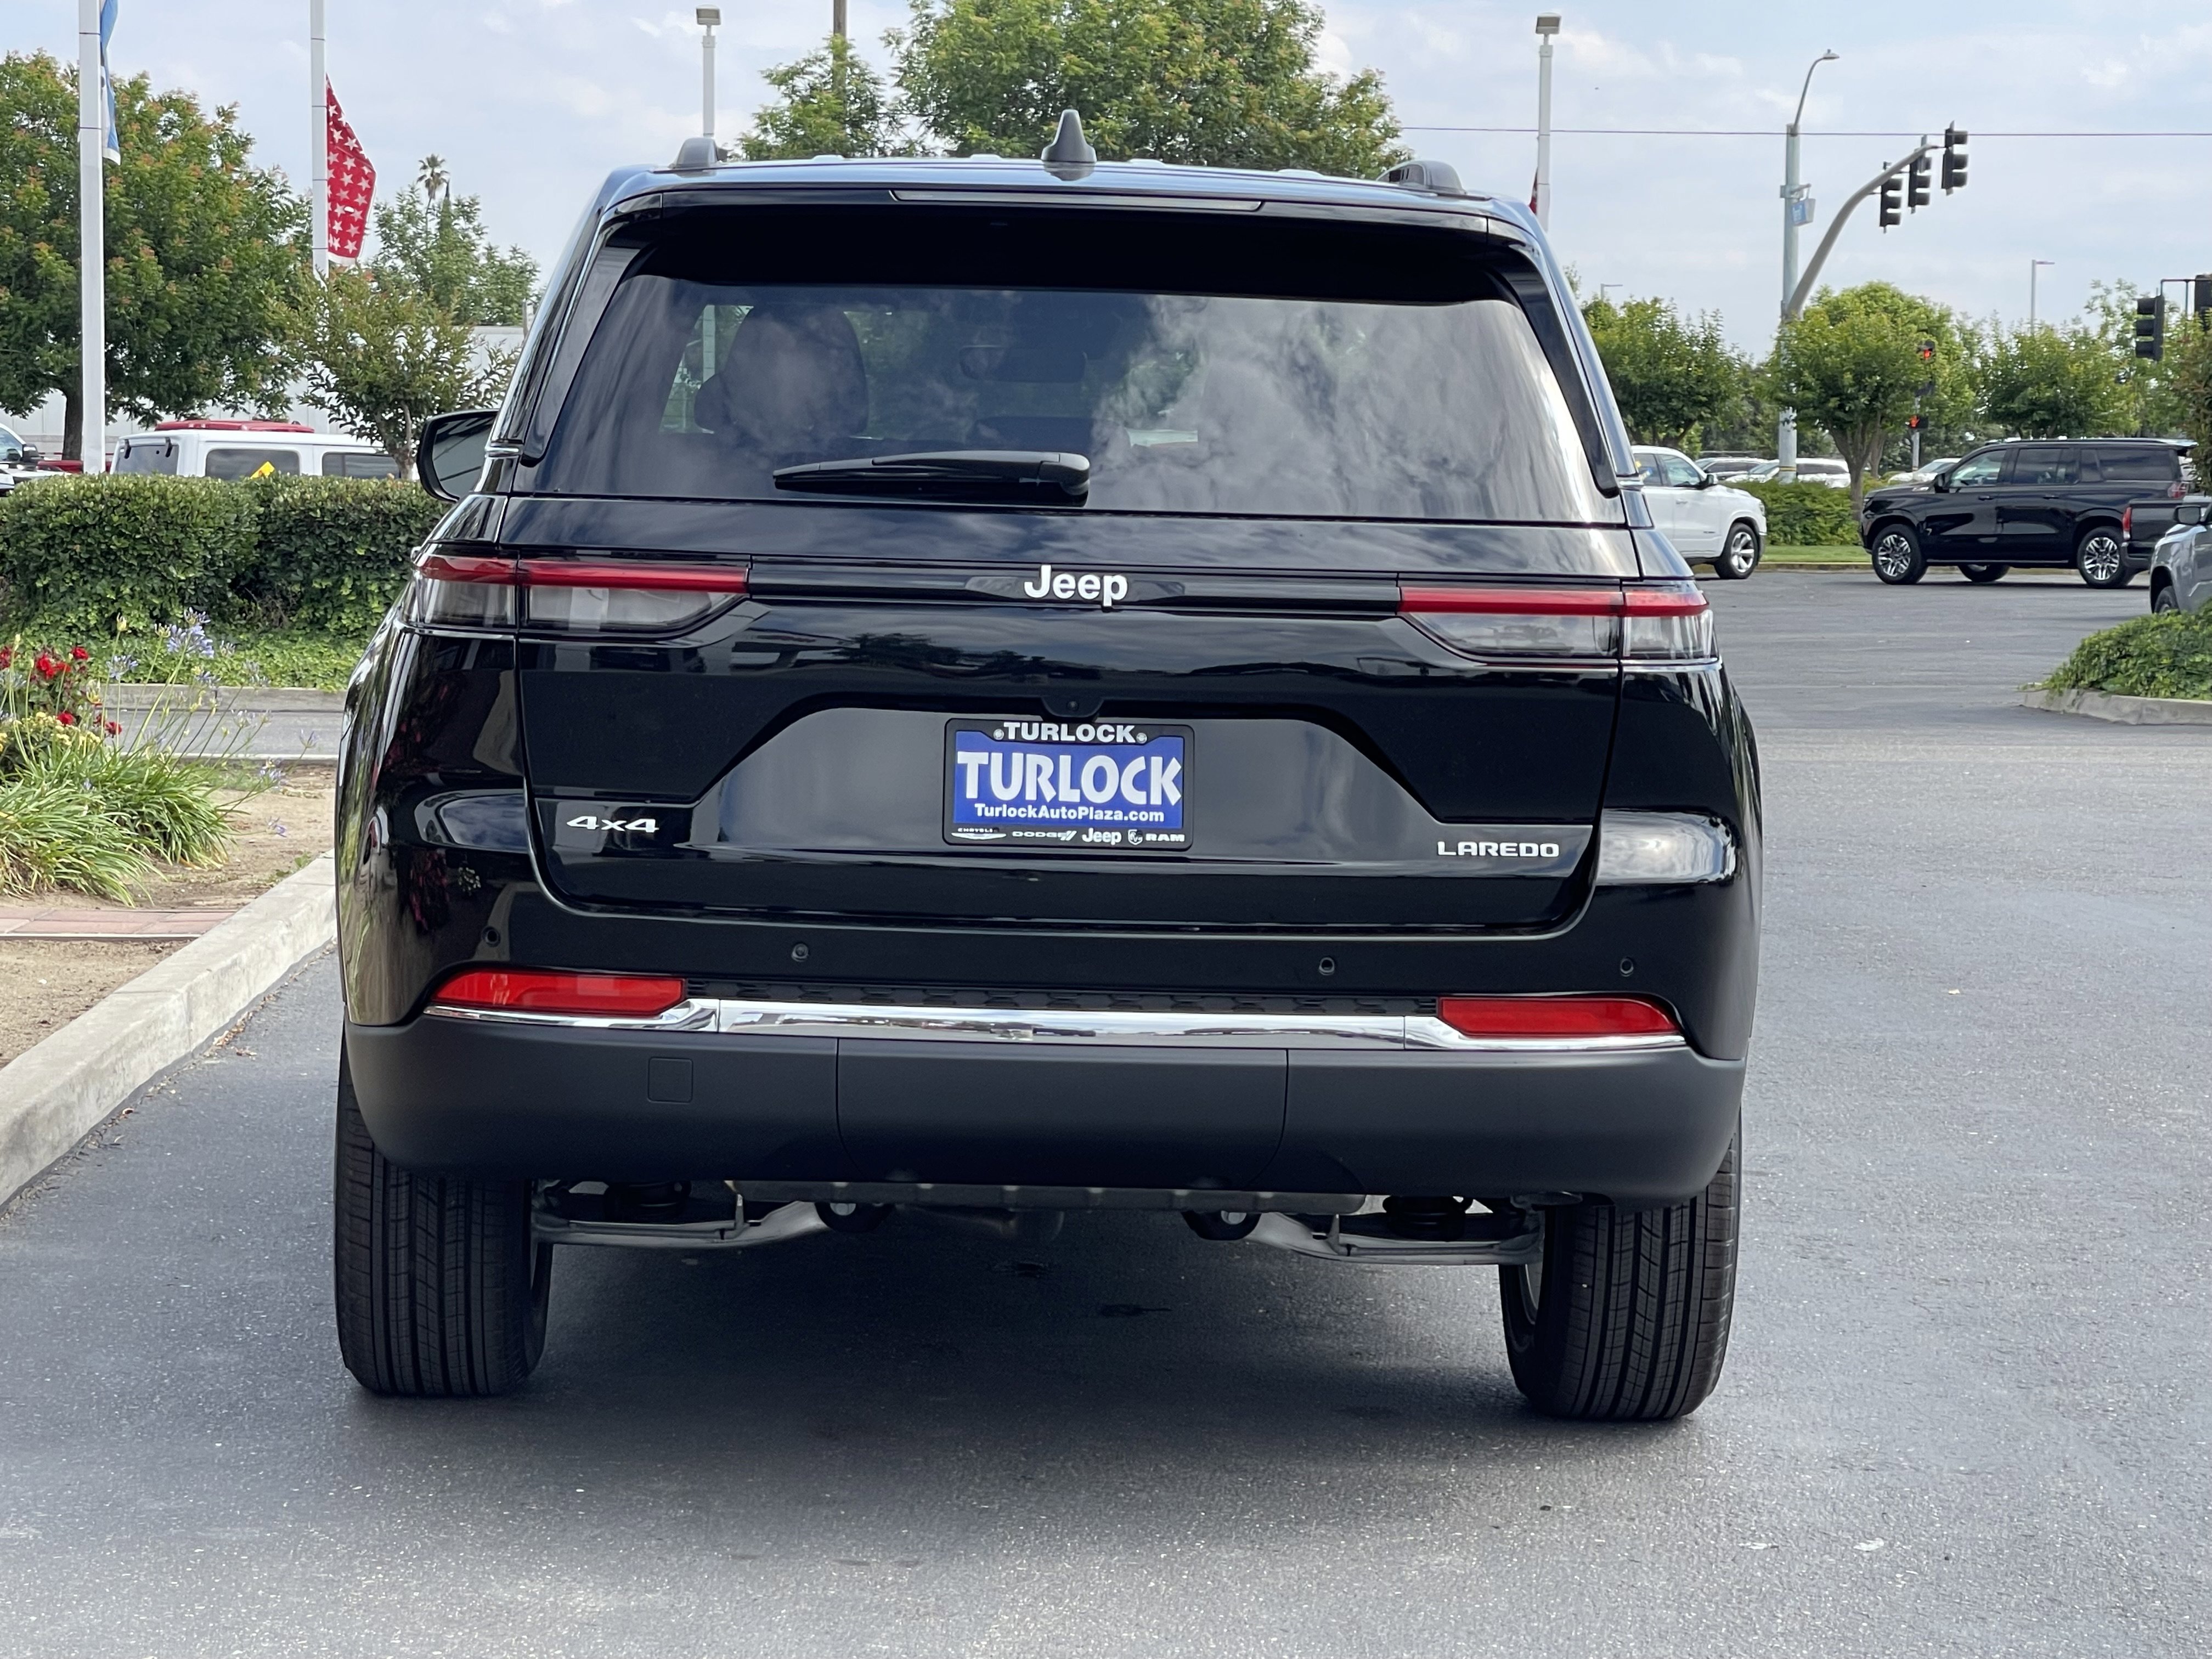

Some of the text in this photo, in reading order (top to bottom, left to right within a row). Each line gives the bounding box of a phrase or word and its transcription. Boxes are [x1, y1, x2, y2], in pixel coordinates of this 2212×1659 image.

[1024, 565, 1128, 606] Jeep
[1003, 722, 1136, 743] TURLOCK
[957, 751, 1182, 805] TURLOCK
[974, 803, 1164, 822] TurlockAutoPlaza.com
[567, 816, 659, 833] 4x4
[1082, 827, 1122, 845] Jeep
[1146, 833, 1185, 842] RAM
[1437, 841, 1560, 857] LAREDO
